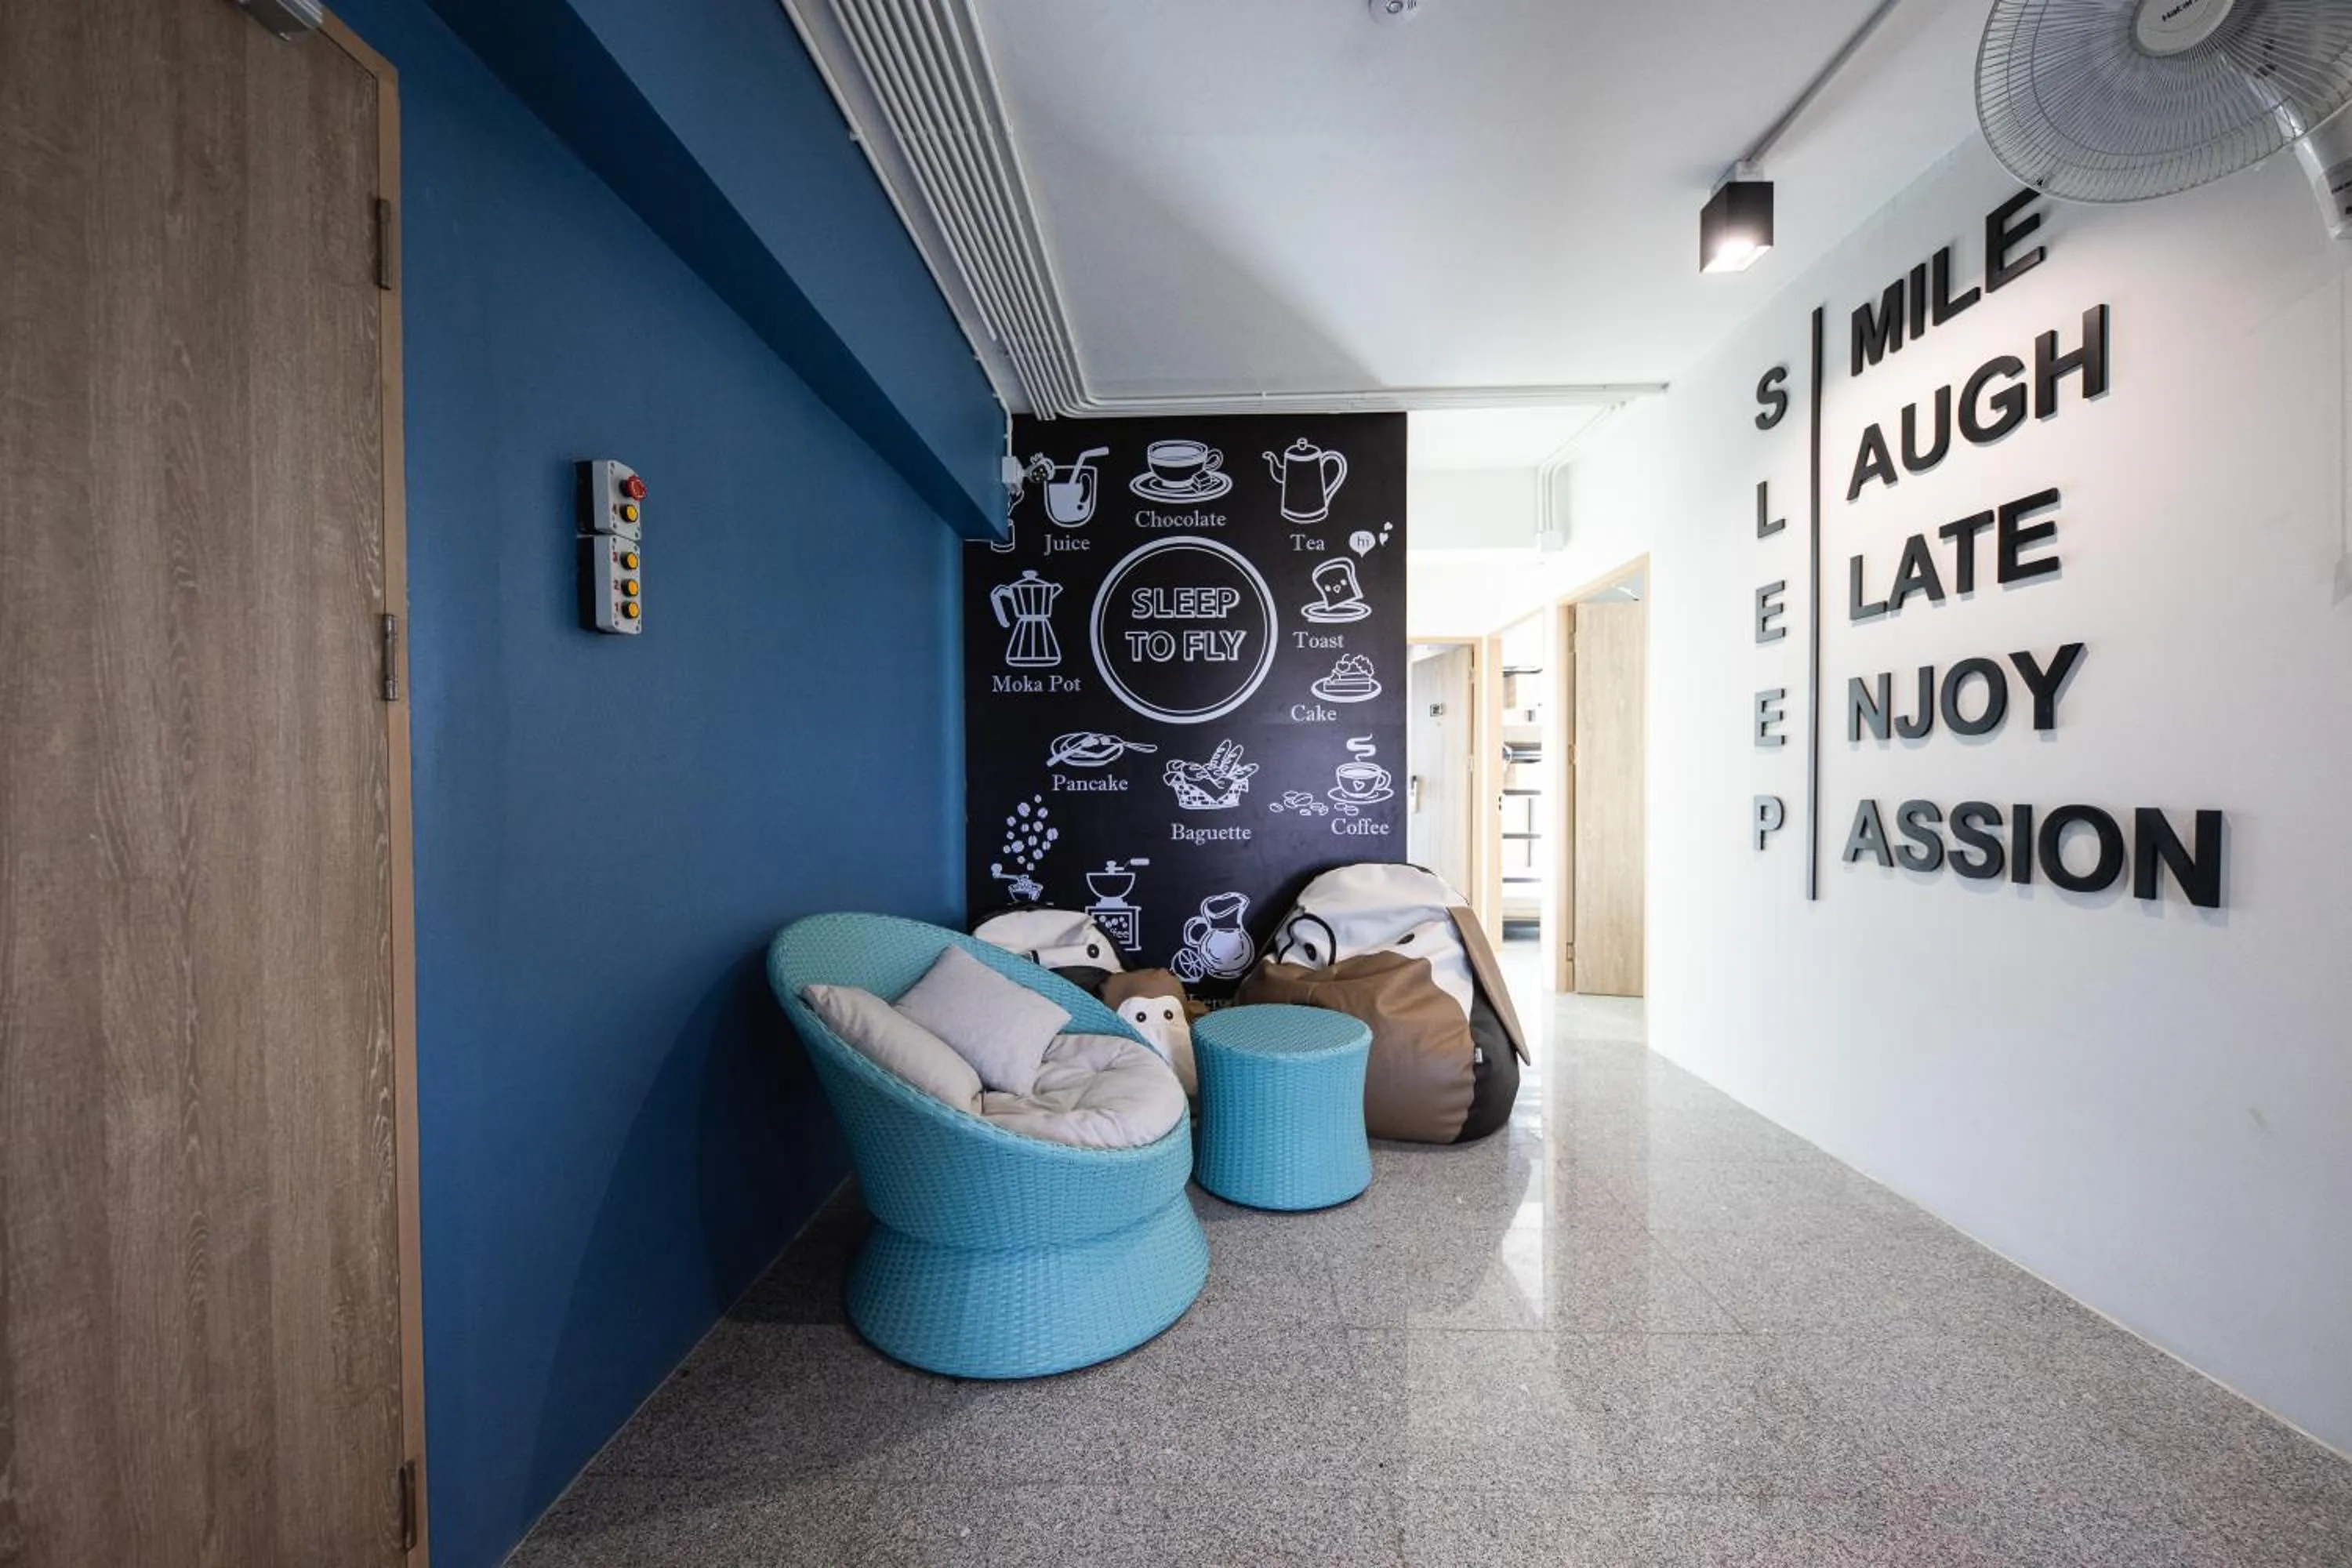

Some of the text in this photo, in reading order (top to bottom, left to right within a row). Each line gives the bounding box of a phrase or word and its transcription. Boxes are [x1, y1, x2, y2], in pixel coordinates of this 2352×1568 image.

[1851, 179, 2045, 377] MILE
[1846, 303, 2110, 502] AUGH
[1134, 510, 1227, 528] Chocolate
[1044, 534, 1091, 556] Juice
[1290, 535, 1326, 550] Tea
[1357, 535, 1370, 547] hi
[1849, 487, 2060, 622] LATE
[1131, 586, 1240, 619] SLEEP
[1125, 630, 1247, 662] TO FLY
[1293, 631, 1345, 649] Toast
[992, 675, 1081, 691] Moka Pot
[1848, 642, 2083, 742] NJOY
[1290, 703, 1338, 722] Cake
[1052, 774, 1129, 792] Pancake
[1171, 823, 1252, 845] Baguette
[1330, 818, 1391, 836] Coffee
[1842, 798, 2223, 908] ASSION
